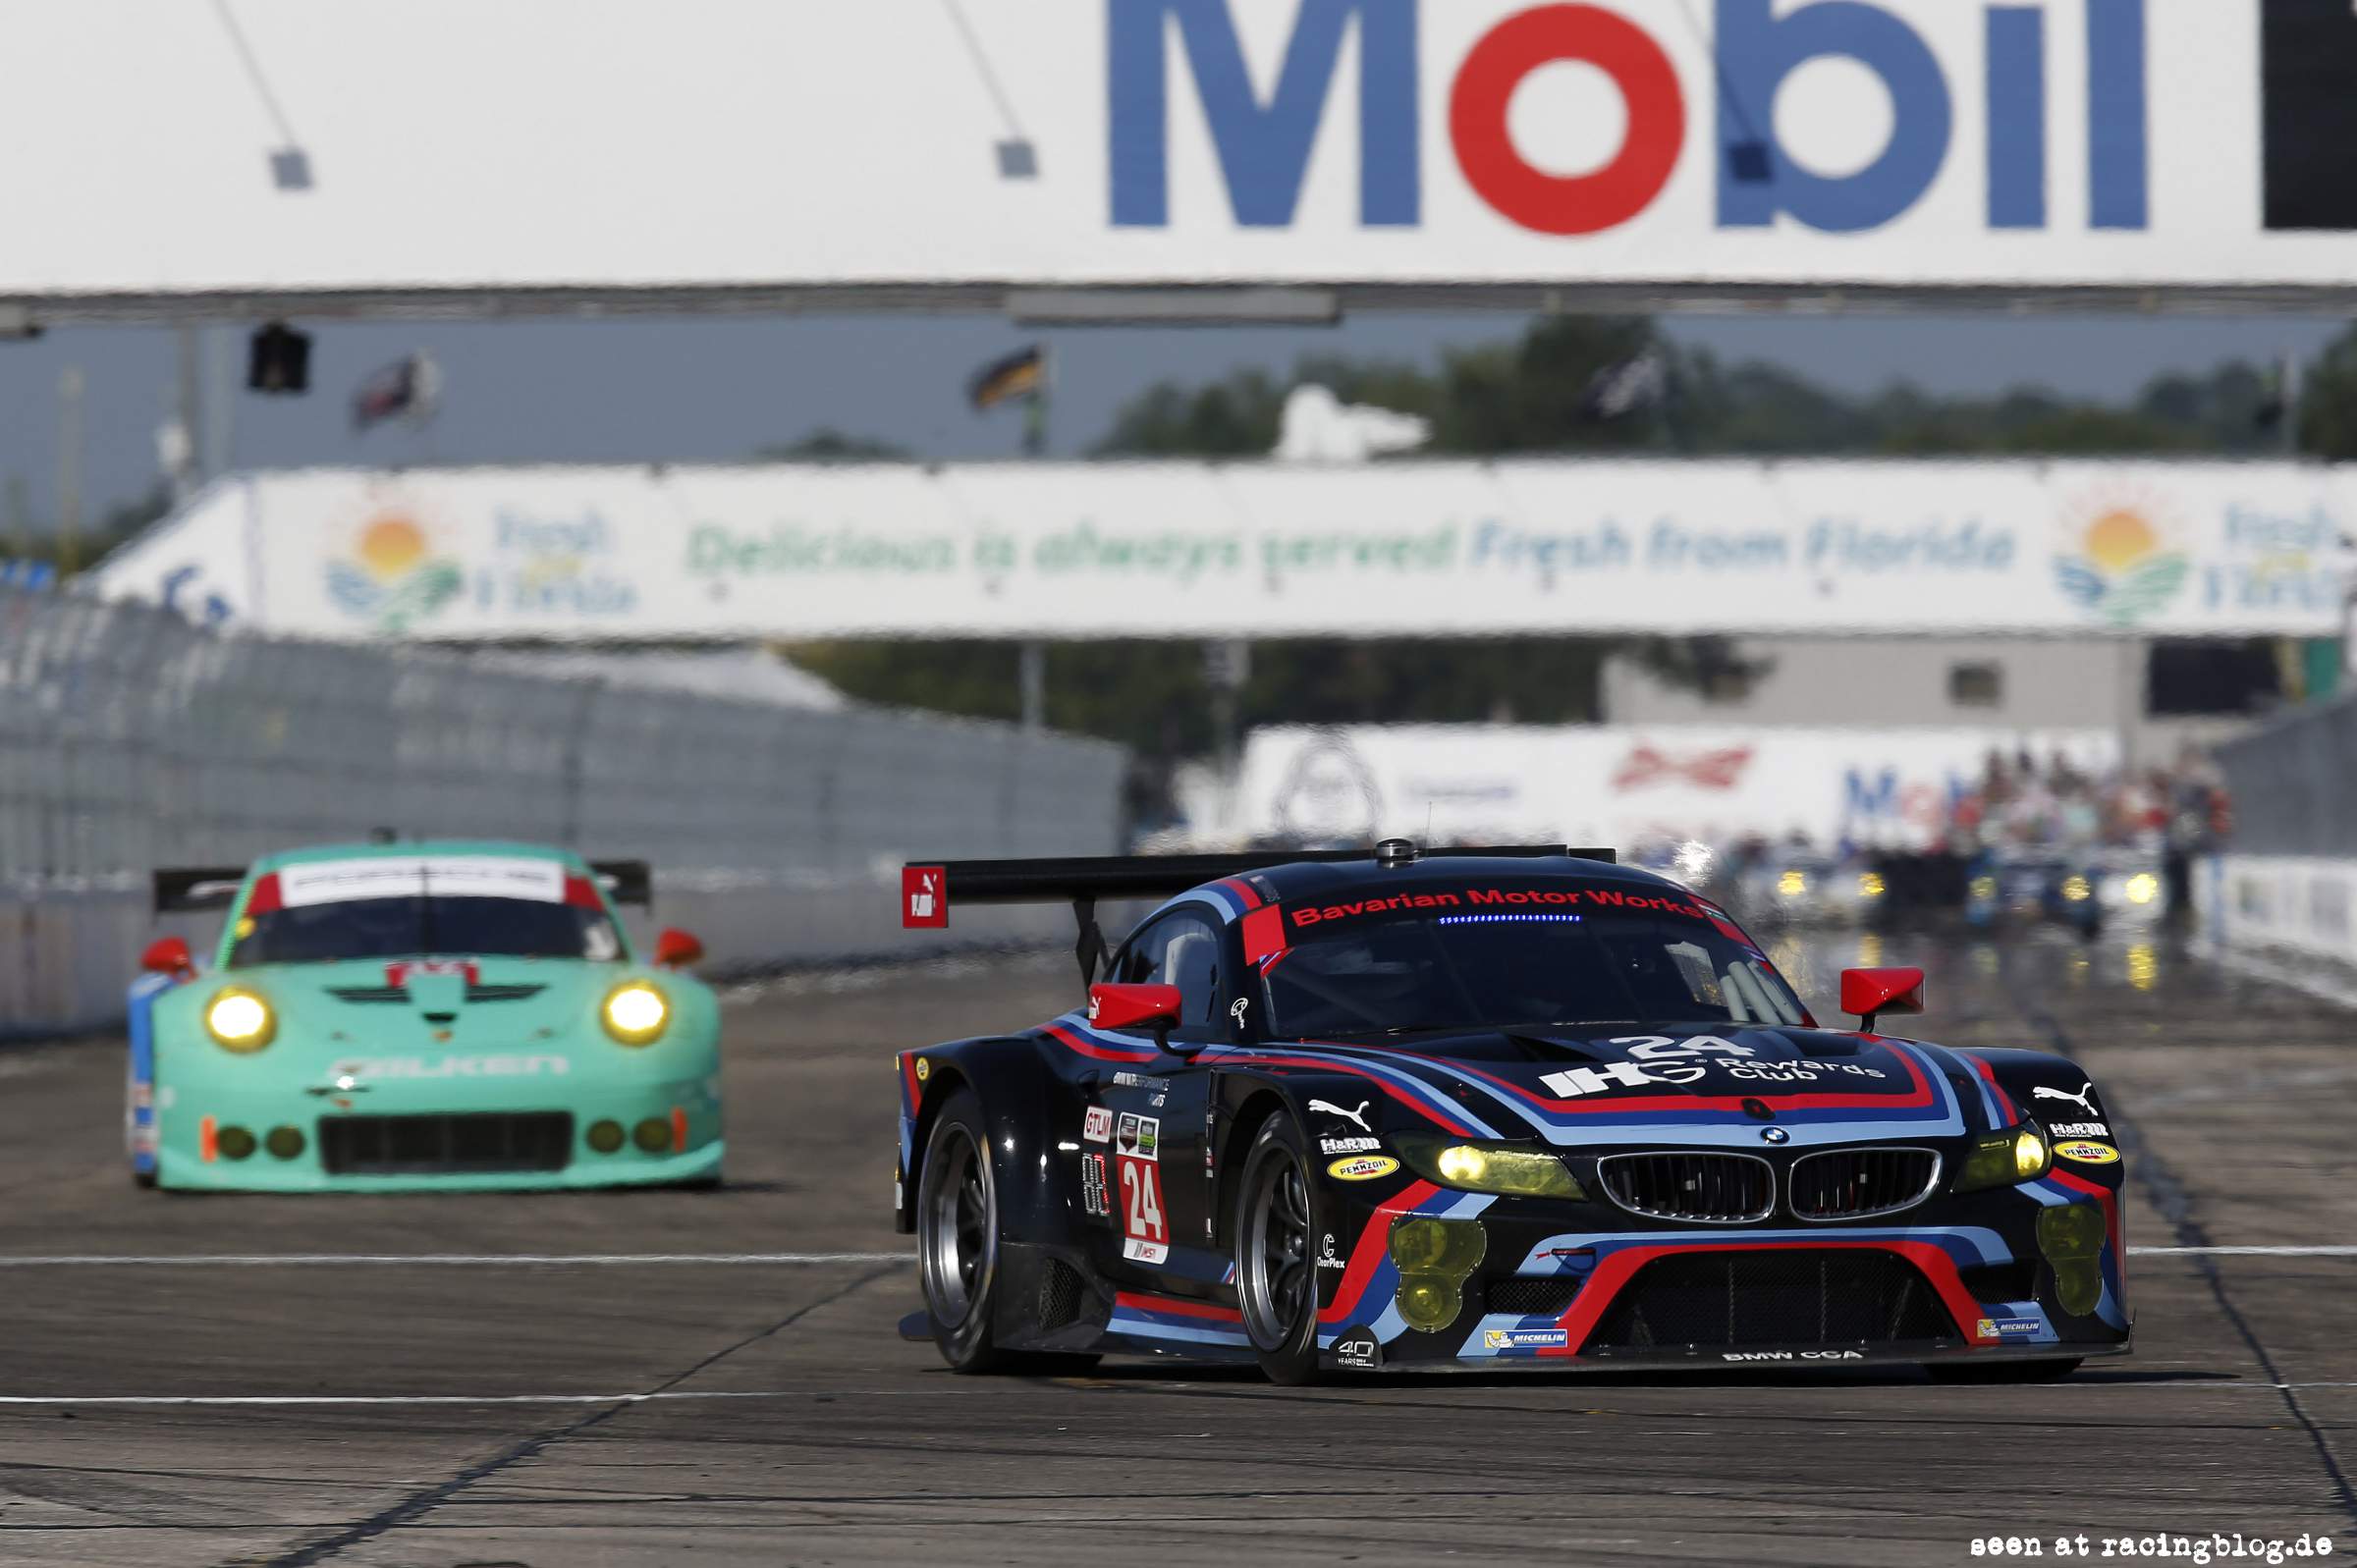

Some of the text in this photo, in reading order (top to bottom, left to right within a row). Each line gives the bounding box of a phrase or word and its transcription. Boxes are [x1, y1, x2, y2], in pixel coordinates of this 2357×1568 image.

[1107, 0, 2151, 236] Mobil
[689, 515, 2015, 589] Delicious is always served Fresh from Florida
[1291, 888, 1707, 928] Bavarian Motor Works
[1610, 1036, 1757, 1061] 24
[1716, 1057, 1887, 1079] Rewards
[1729, 1067, 1819, 1081] Club
[1085, 1110, 1111, 1137] GTLM
[2063, 1147, 2110, 1157] PENNZOIL
[1340, 1159, 1389, 1175] PENNZOIL
[1124, 1160, 1163, 1241] 24
[2000, 1322, 2040, 1330] MICHELIN
[1513, 1333, 1565, 1342] MICHELIN
[1338, 1340, 1375, 1357] 40
[1722, 1350, 1864, 1362] BMW CCA
